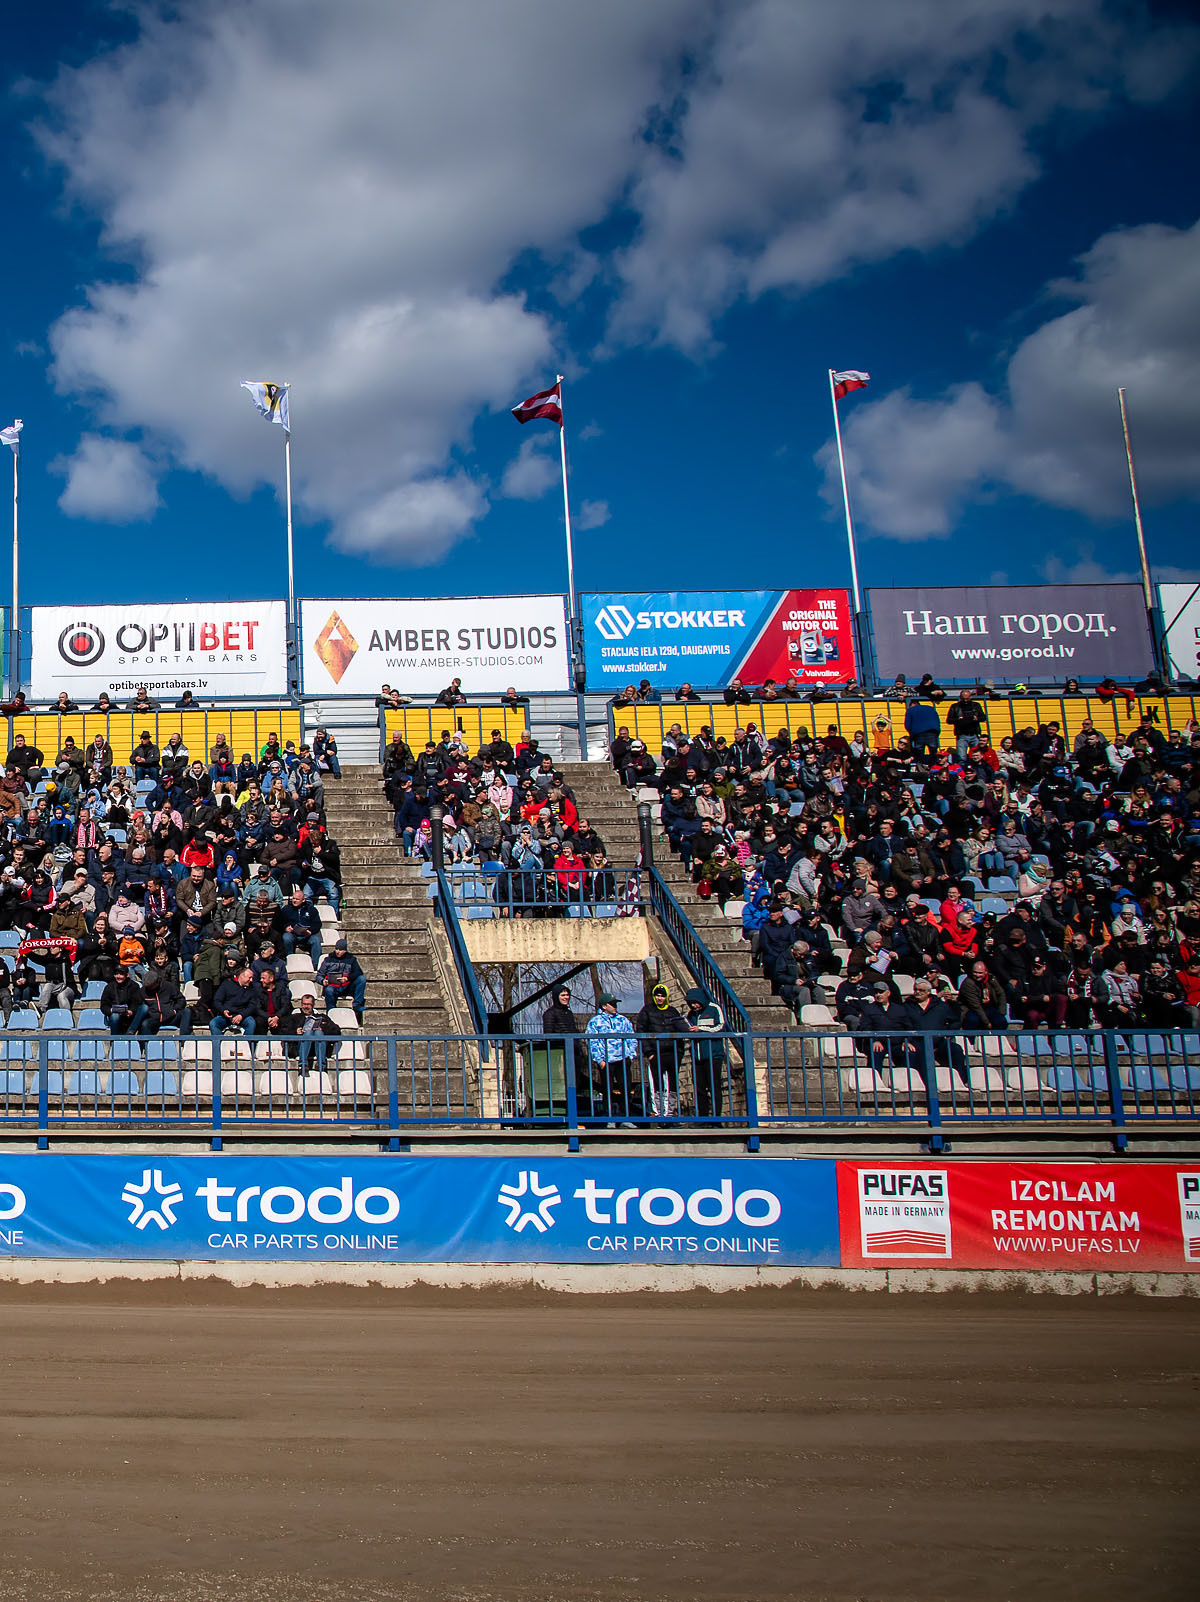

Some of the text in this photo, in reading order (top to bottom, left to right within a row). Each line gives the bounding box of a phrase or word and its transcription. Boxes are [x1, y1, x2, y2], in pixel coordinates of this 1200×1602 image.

[817, 600, 837, 610] THE
[636, 610, 746, 629] STOKKER
[789, 611, 838, 620] ORIGINAL
[782, 620, 839, 631] MOTOR OIL
[902, 610, 1118, 640] Наш город.
[116, 621, 259, 653] OPTIBET
[368, 626, 557, 652] AMBER STUDIOS
[118, 653, 258, 664] SPORTA BĀRS
[601, 647, 640, 657] STACIJAS
[641, 647, 658, 656] IELA
[681, 645, 731, 655] DAUGAVPILS
[951, 645, 1076, 661] www.gorod.lv
[386, 655, 544, 668] WWW.AMBER-STUDIOS.COM
[602, 661, 667, 673] www.stokker.lv
[805, 669, 841, 677] Valvoline
[109, 679, 208, 691] optibetsportabars.lv
[863, 1174, 943, 1197] PUFAS
[1011, 1180, 1115, 1203] IZCILAM
[195, 1176, 400, 1225] trodo
[573, 1178, 781, 1227] trodo
[865, 1206, 945, 1218] MADE IN GERMANY
[1186, 1210, 1200, 1220] MA
[991, 1209, 1140, 1232] REMONTAM
[207, 1232, 399, 1250] CAR PARTS ONLINE
[587, 1235, 780, 1253] CAR PARTS ONLINE
[993, 1237, 1140, 1253] WWW.PUFAS.LV
